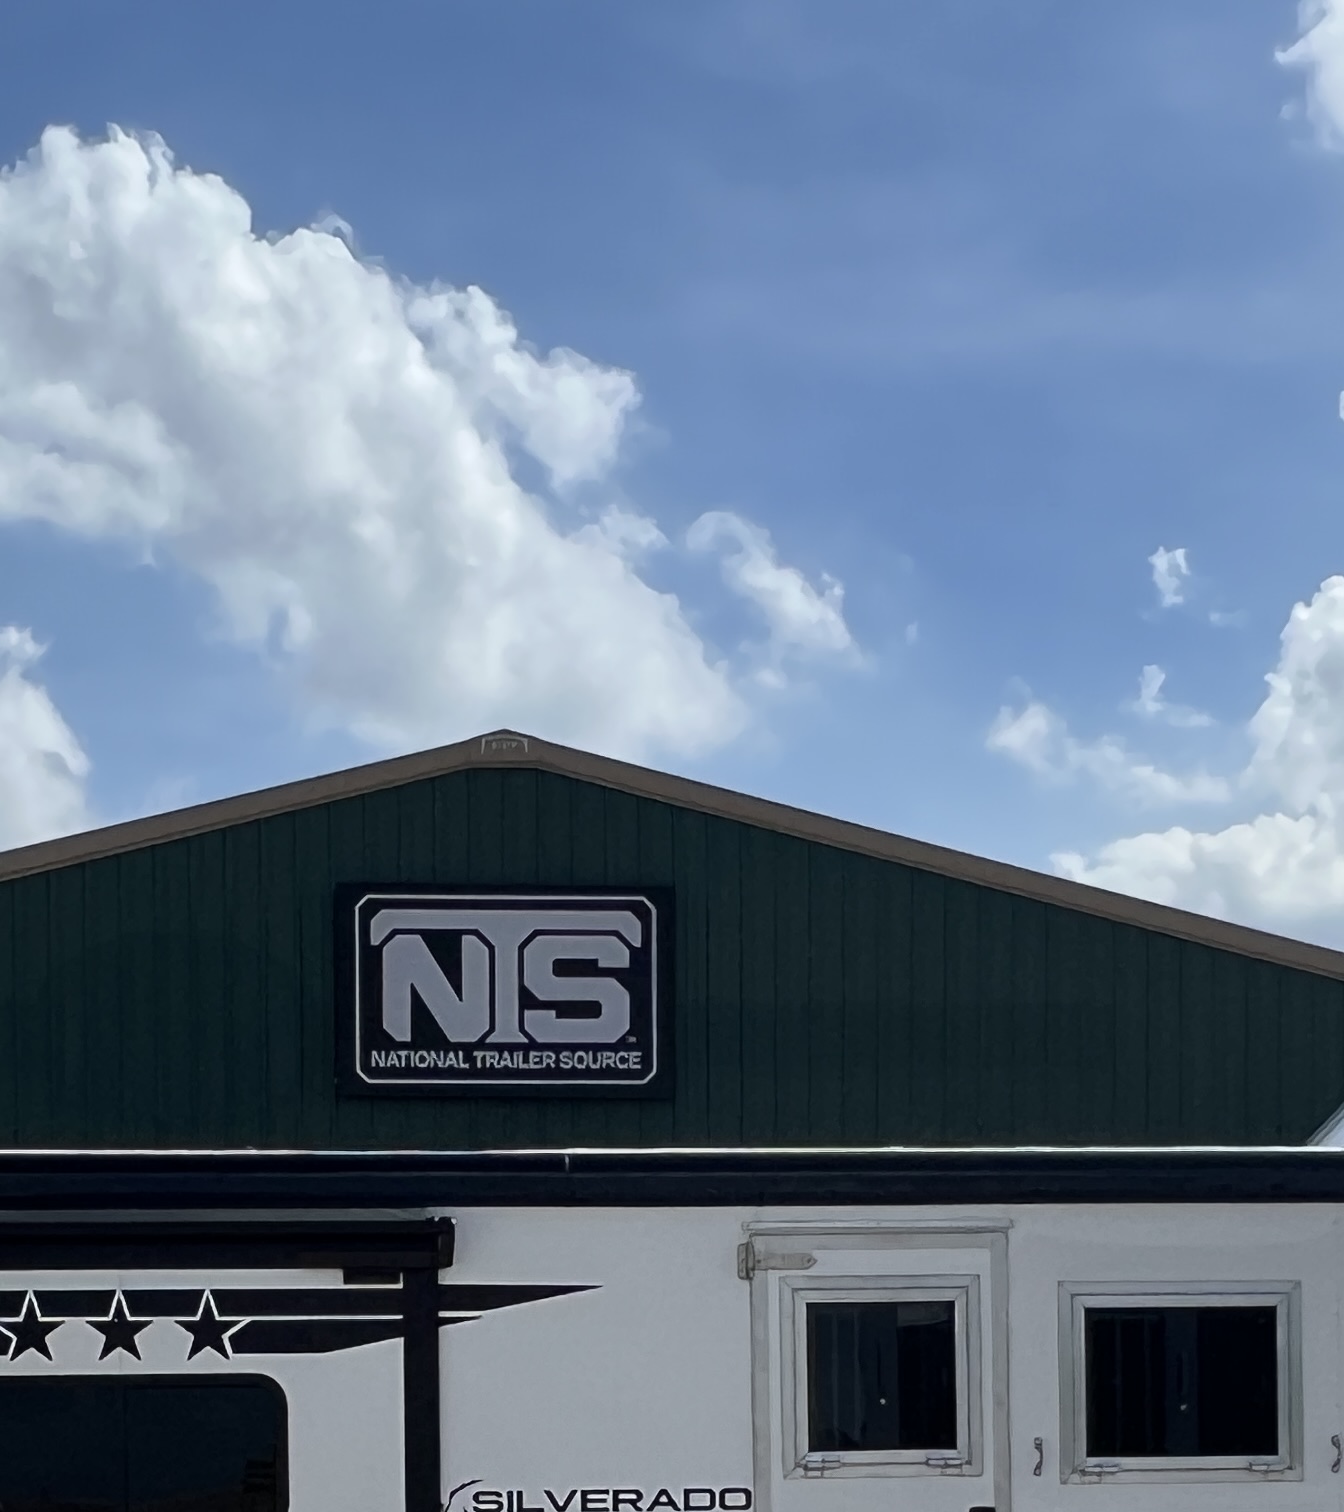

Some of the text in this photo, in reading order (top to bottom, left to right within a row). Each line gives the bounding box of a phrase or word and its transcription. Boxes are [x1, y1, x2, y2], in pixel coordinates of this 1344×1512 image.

[370, 908, 642, 1043] NTS
[370, 1051, 642, 1069] NATIONAL TRAILER SOURCE
